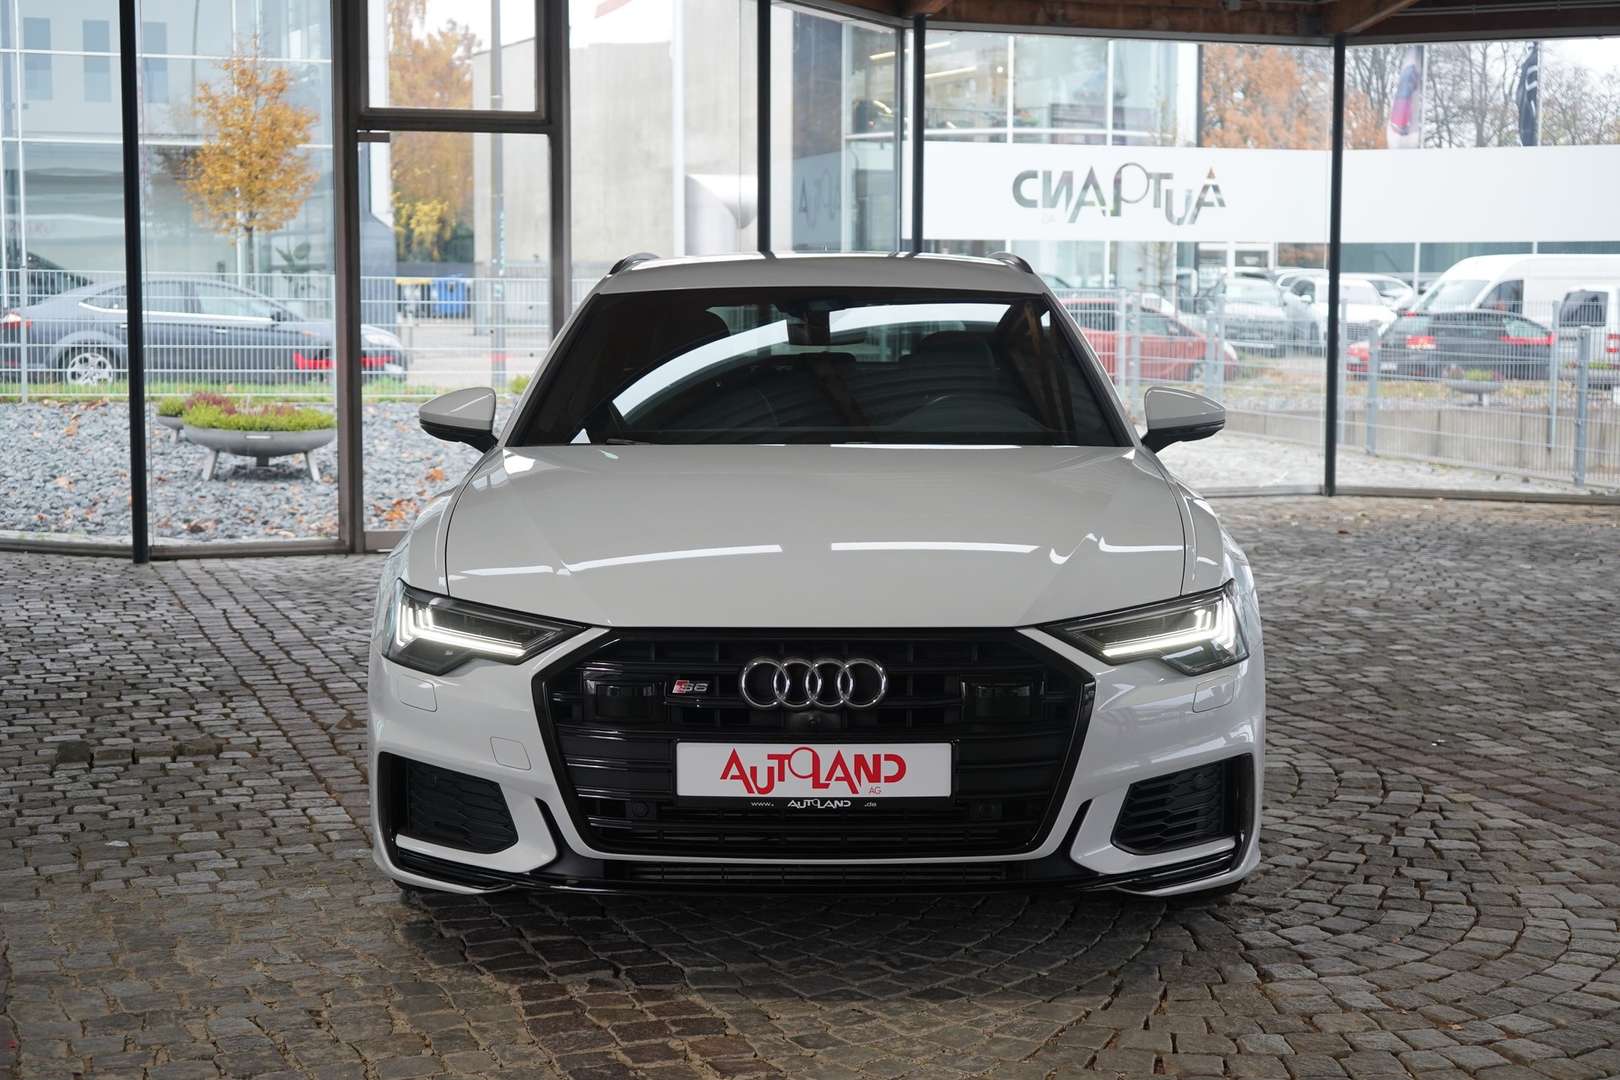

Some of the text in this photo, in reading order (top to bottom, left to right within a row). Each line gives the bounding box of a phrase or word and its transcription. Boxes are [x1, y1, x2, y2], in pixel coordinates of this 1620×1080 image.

[672, 680, 708, 694] S6
[720, 747, 907, 795] AUTOLAND
[868, 786, 882, 795] AG
[787, 798, 851, 809] AUTOLAND
